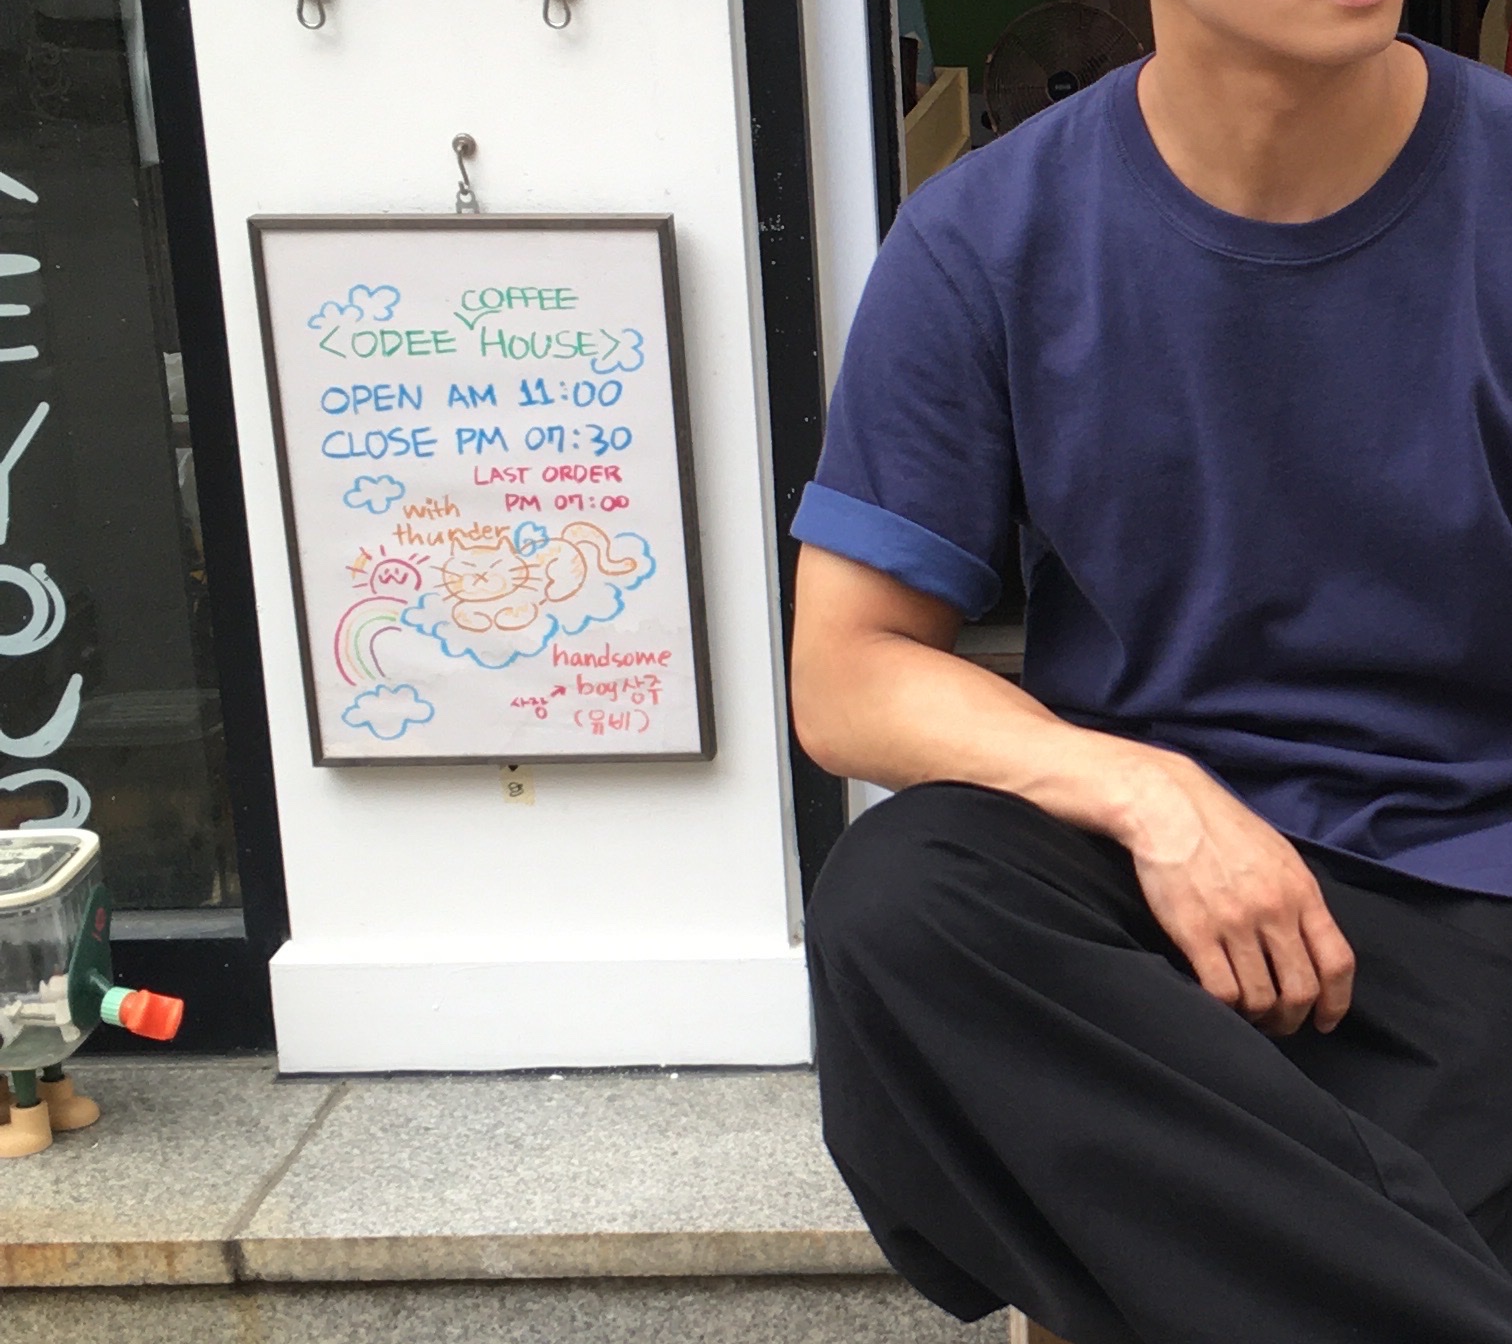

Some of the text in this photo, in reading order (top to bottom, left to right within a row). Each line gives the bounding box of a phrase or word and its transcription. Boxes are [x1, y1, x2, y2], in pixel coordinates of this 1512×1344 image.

[460, 286, 580, 312] COFFEE
[320, 377, 624, 415] OPEN AM 11:00
[320, 423, 633, 460] CLOSE PM 07:30
[473, 463, 624, 486] LAST ORDER
[402, 493, 462, 521] with
[504, 492, 631, 513] PM 07:00
[391, 520, 512, 548] thunder
[552, 641, 673, 669] handsome
